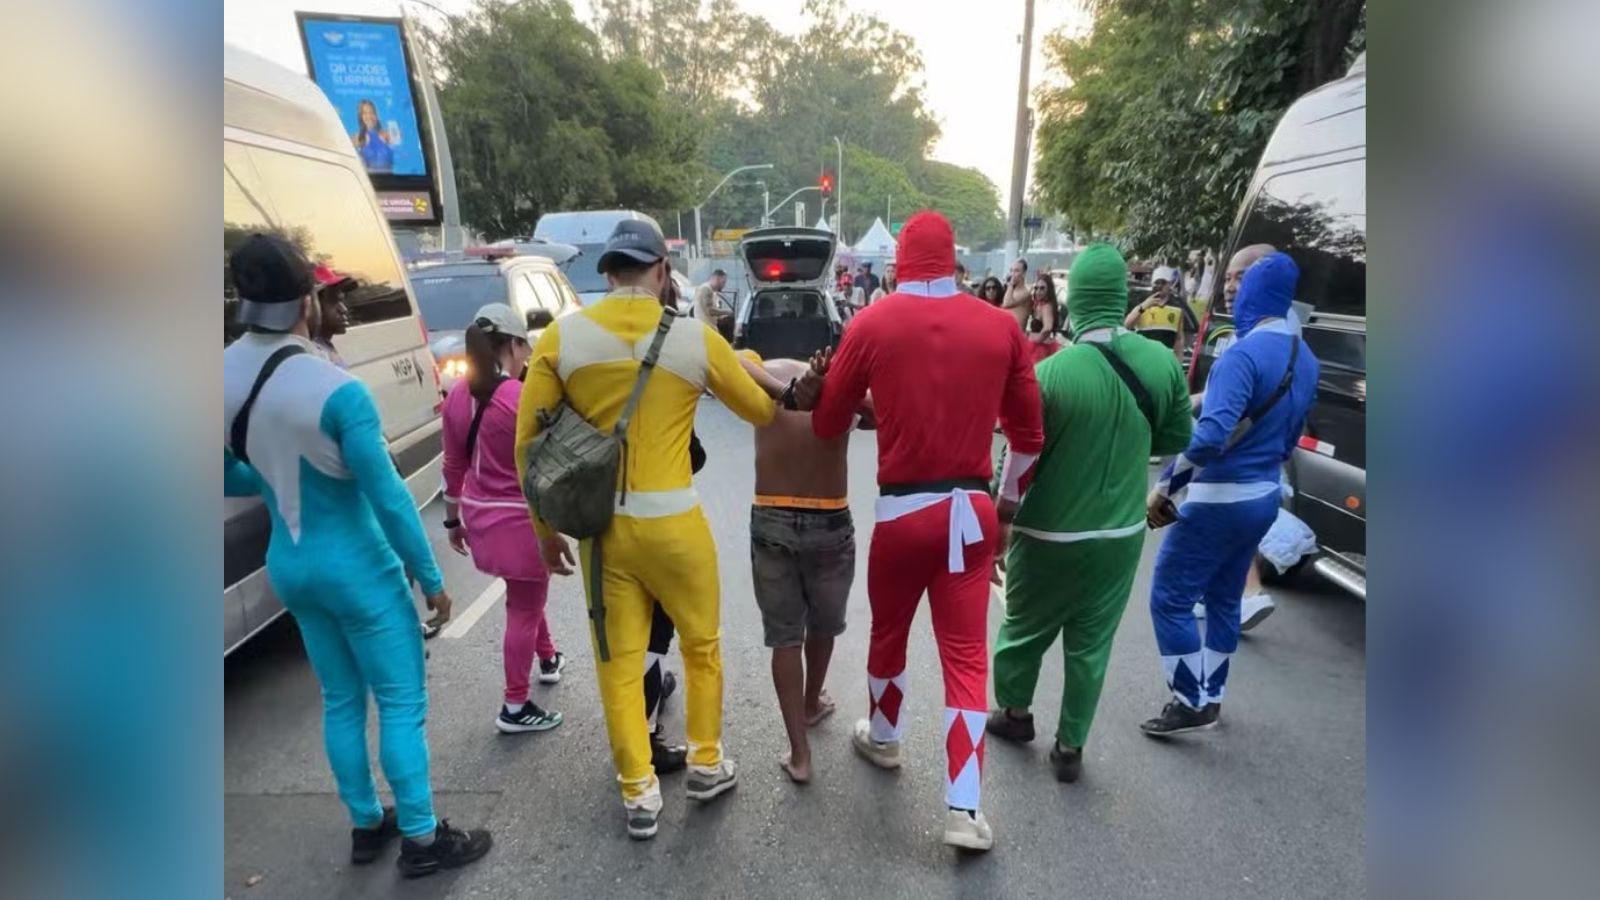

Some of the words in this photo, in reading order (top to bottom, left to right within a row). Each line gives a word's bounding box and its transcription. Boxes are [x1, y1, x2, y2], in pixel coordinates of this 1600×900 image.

[330, 63, 346, 73] QR
[348, 63, 388, 75] CODES
[332, 74, 392, 87] SURPRESA
[391, 358, 412, 377] MGP
